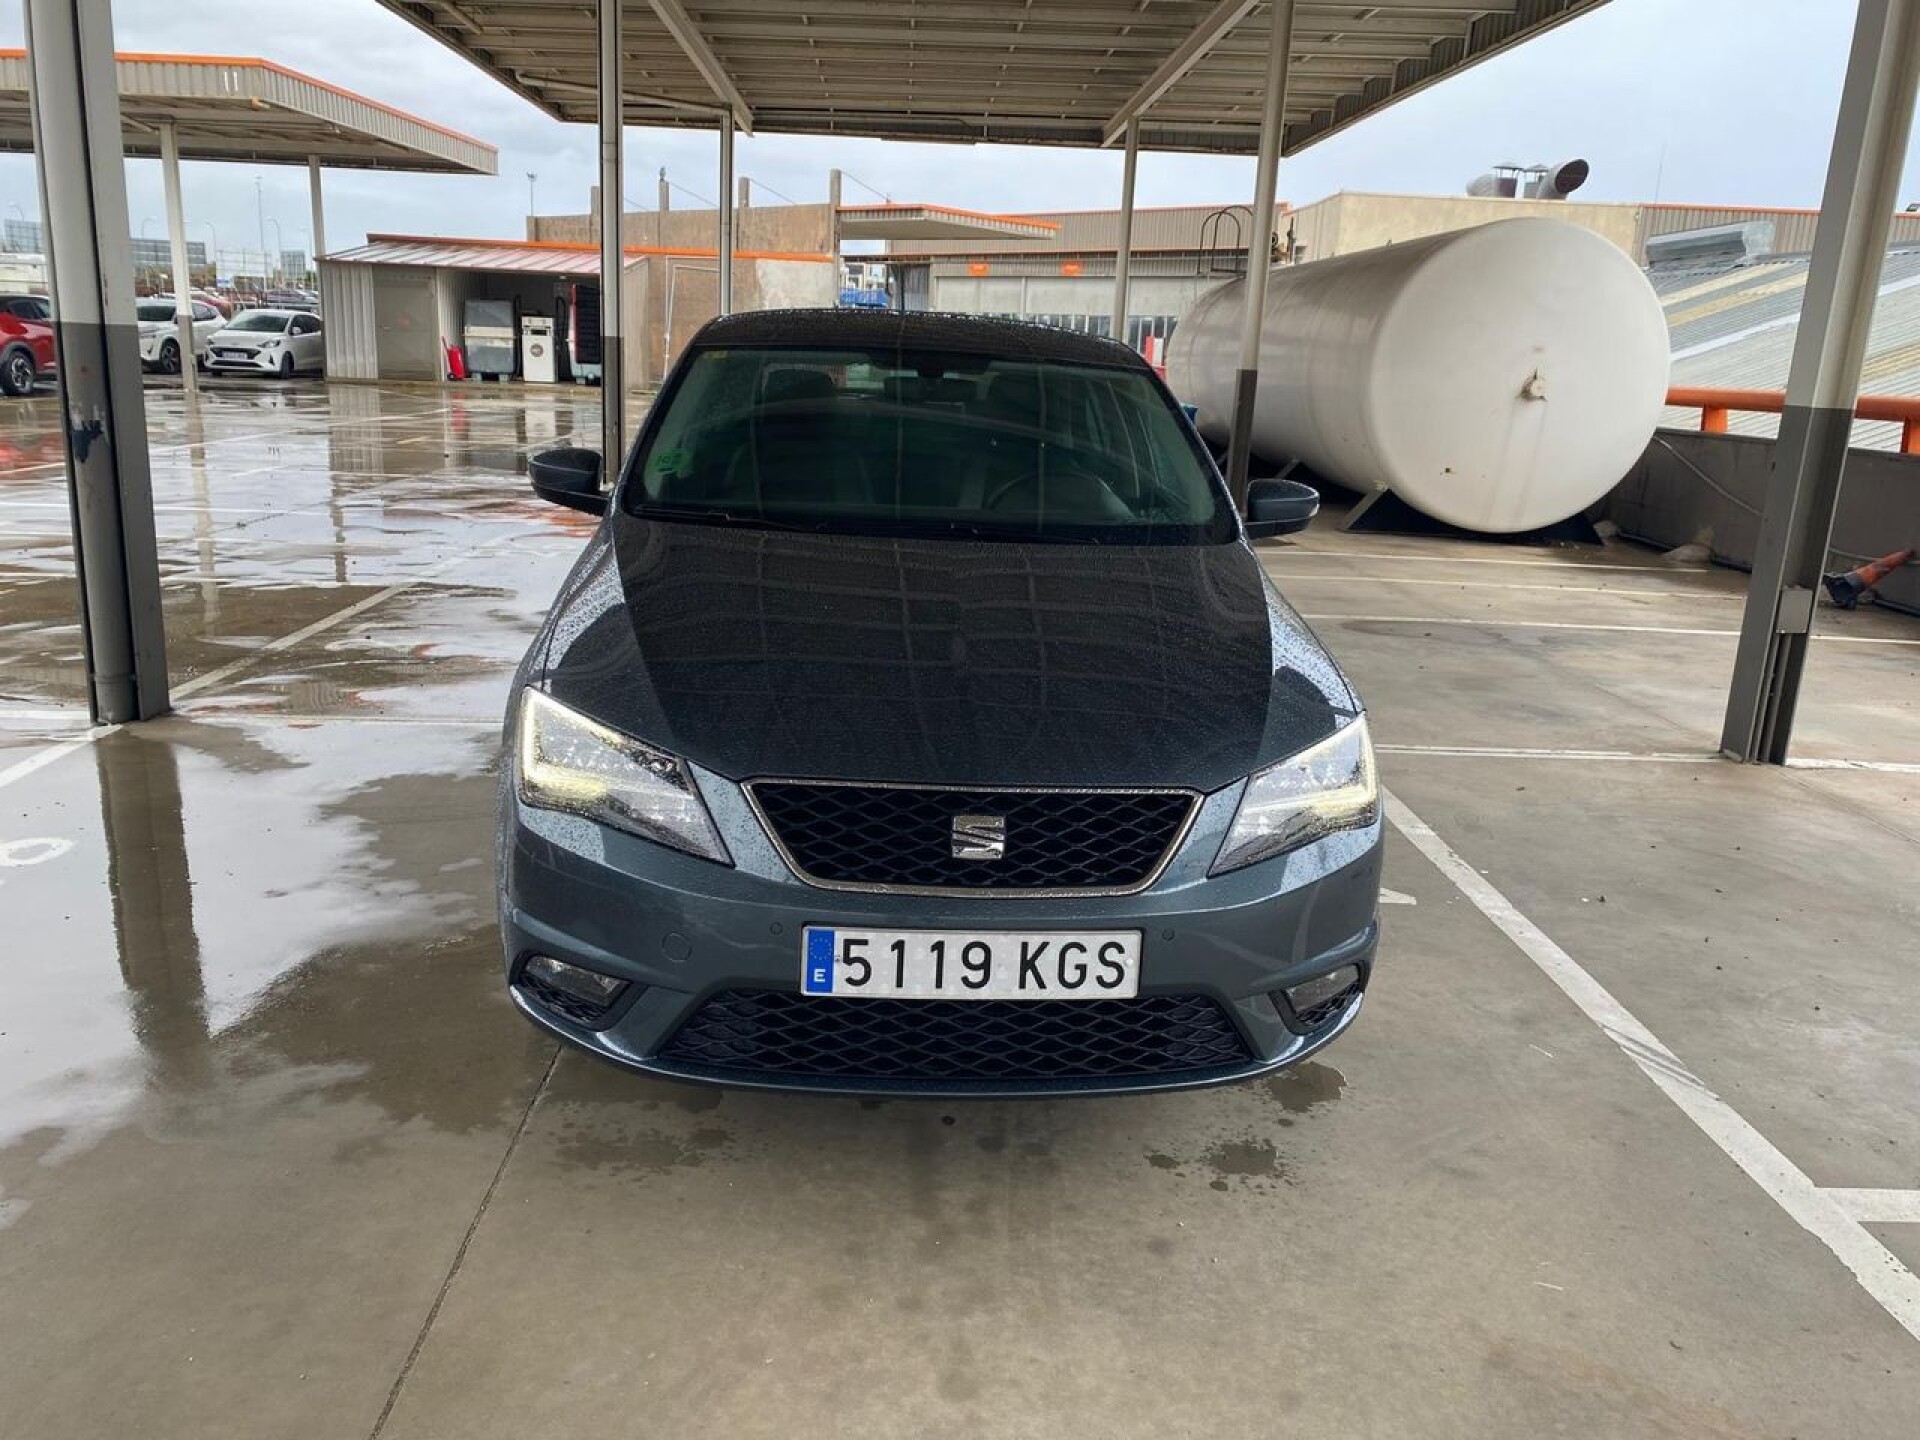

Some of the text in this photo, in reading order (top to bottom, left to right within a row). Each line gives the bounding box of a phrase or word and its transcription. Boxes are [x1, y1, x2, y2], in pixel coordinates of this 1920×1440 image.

[813, 968, 826, 982] E
[842, 938, 1126, 990] 5119 KGS
